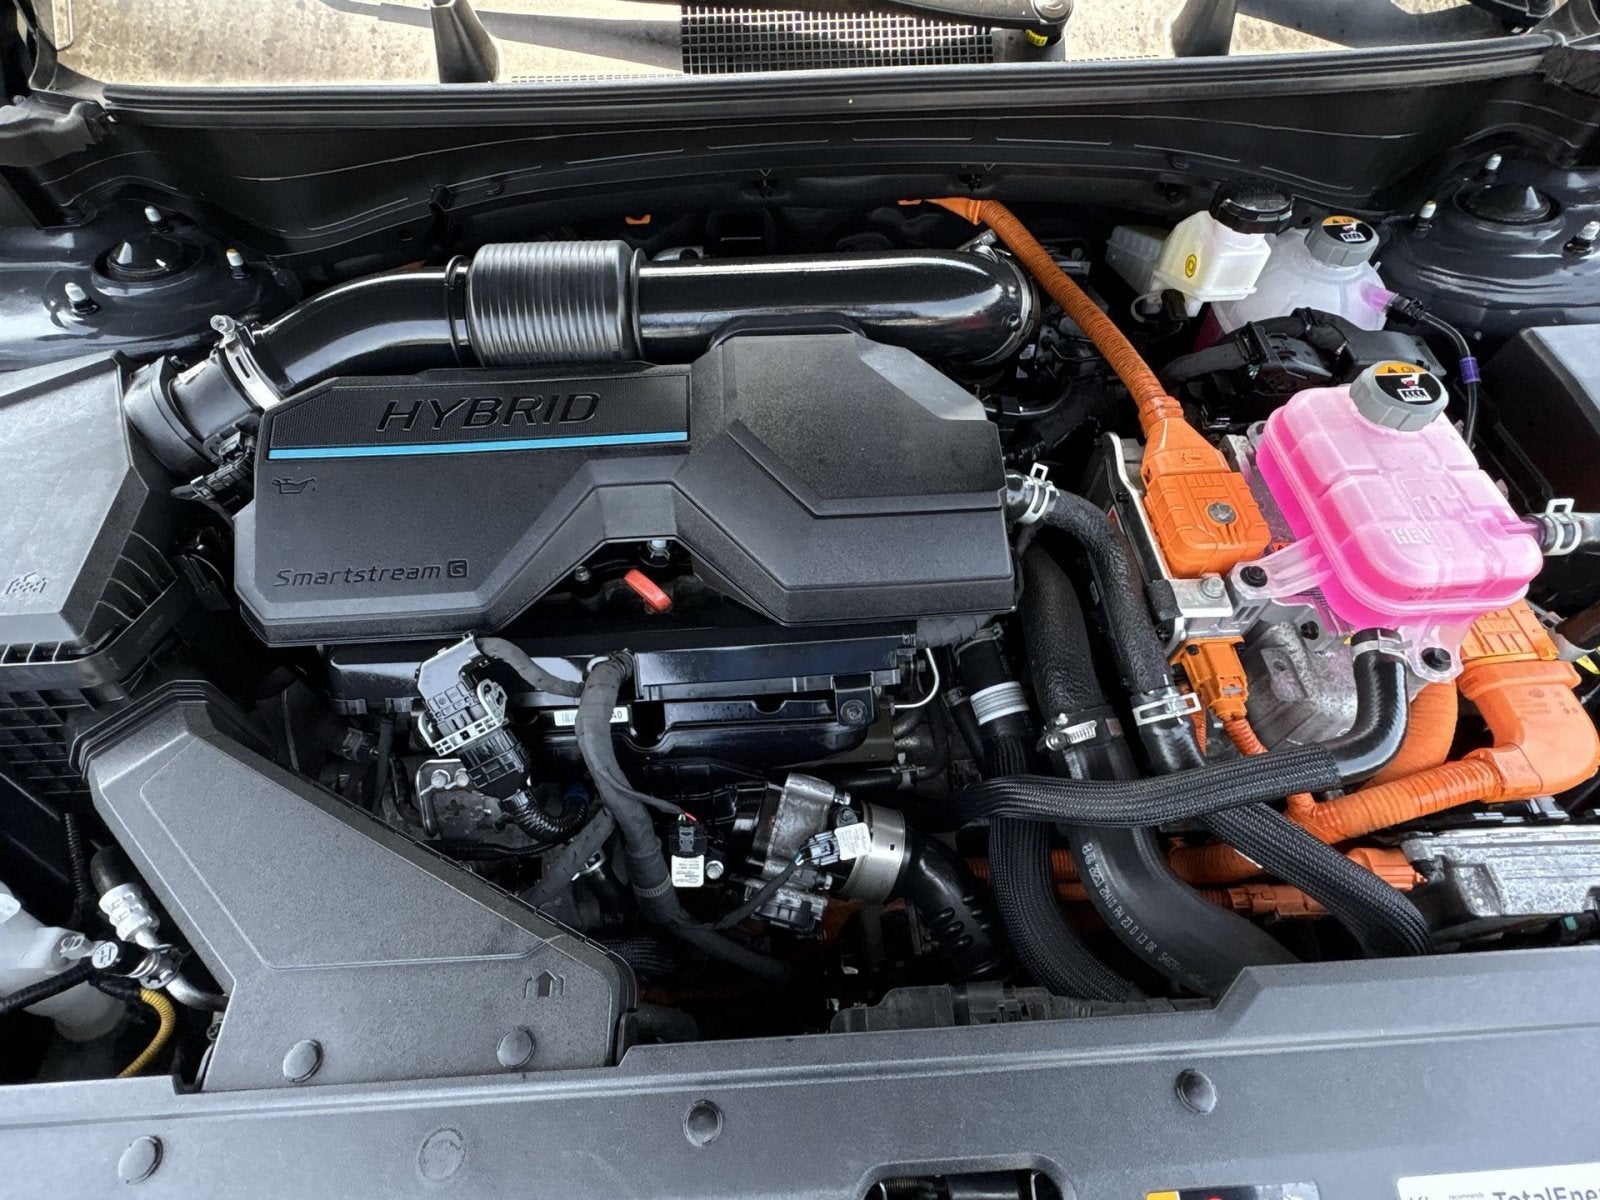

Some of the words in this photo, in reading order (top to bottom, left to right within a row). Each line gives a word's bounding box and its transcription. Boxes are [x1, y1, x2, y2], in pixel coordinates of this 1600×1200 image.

[376, 391, 600, 431] HYBRID
[1391, 528, 1433, 545] HEV
[273, 564, 442, 587] Smartstream
[1121, 916, 1133, 929] 23
